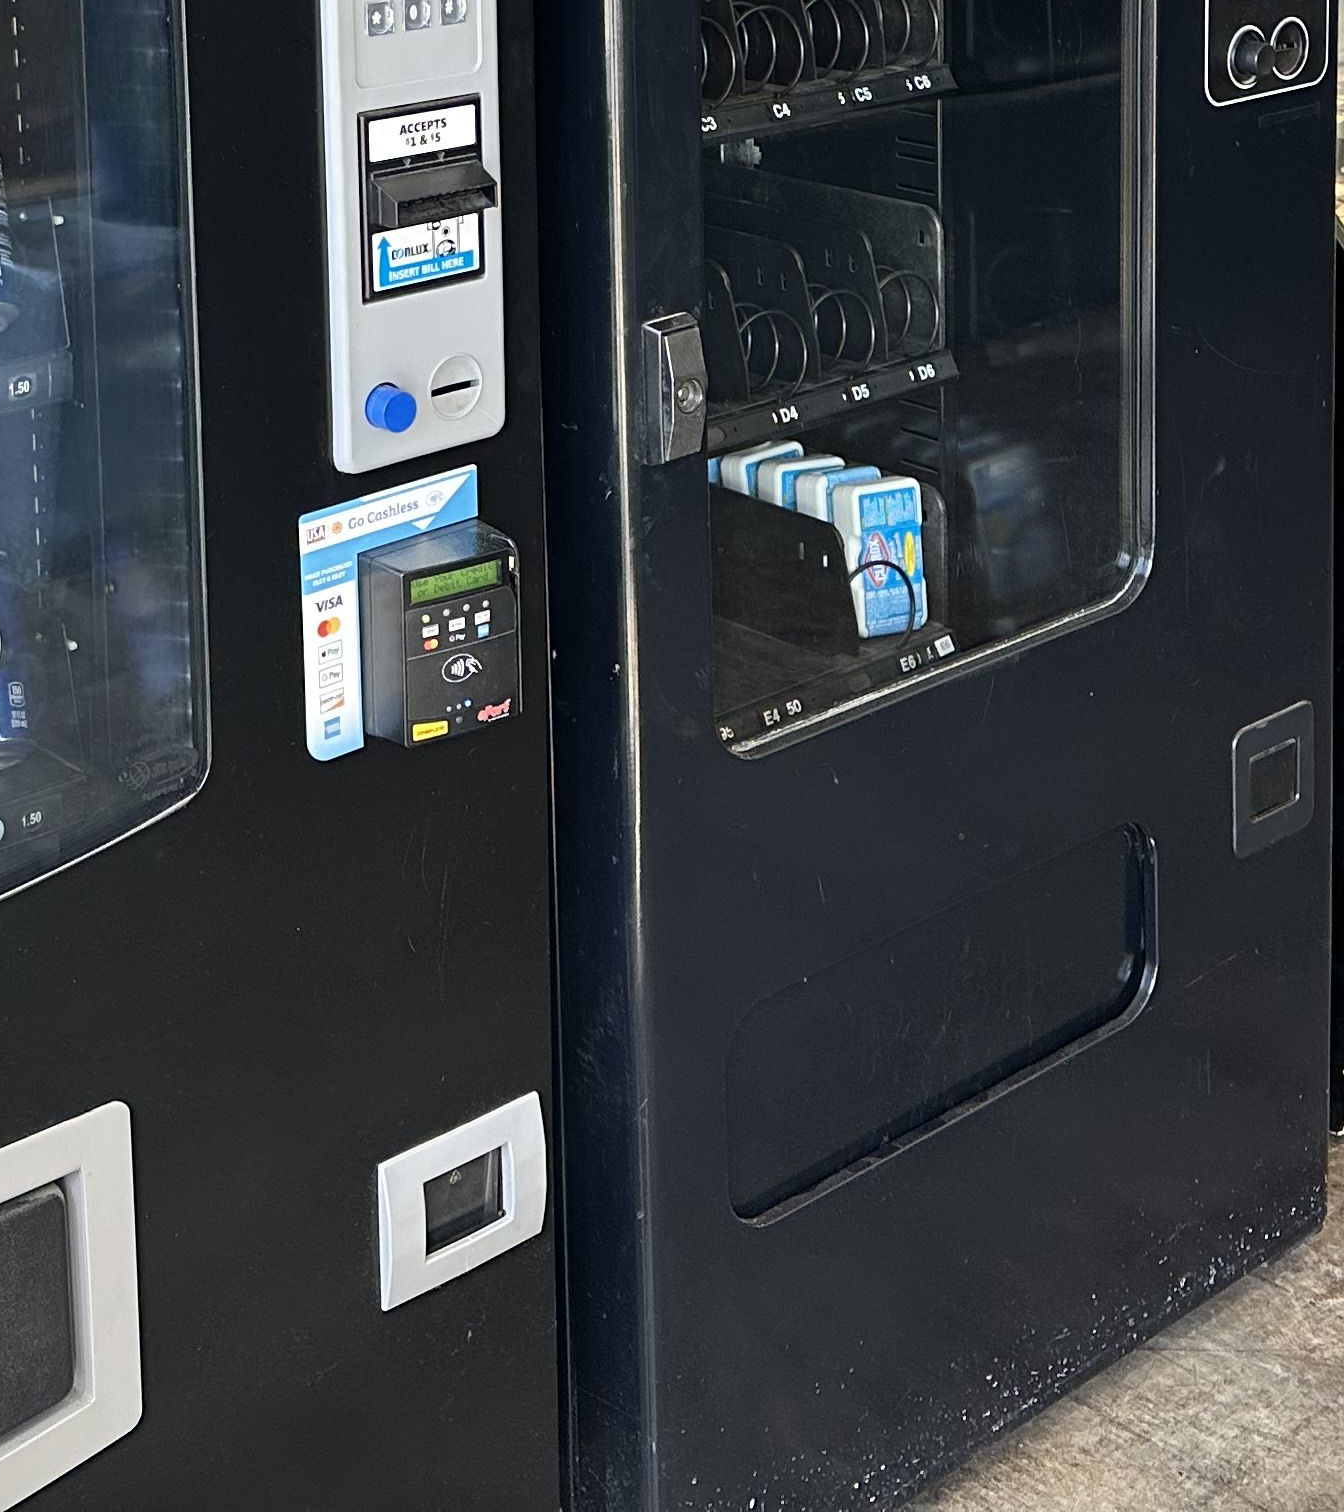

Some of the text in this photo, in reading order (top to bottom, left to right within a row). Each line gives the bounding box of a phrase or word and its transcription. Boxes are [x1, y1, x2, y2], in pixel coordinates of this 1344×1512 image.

[772, 102, 791, 119] C4
[854, 86, 873, 102] C5
[399, 117, 448, 136] ACCEPTS
[419, 134, 428, 146] &
[388, 255, 465, 283] INSERT BILL HERE
[9, 379, 31, 397] 1.50
[779, 363, 936, 423] D4 D5 D6
[306, 498, 419, 545] USA Go Cashless
[315, 594, 344, 614] VISA
[762, 699, 803, 727] E4 50
[22, 810, 43, 829] 1.50
